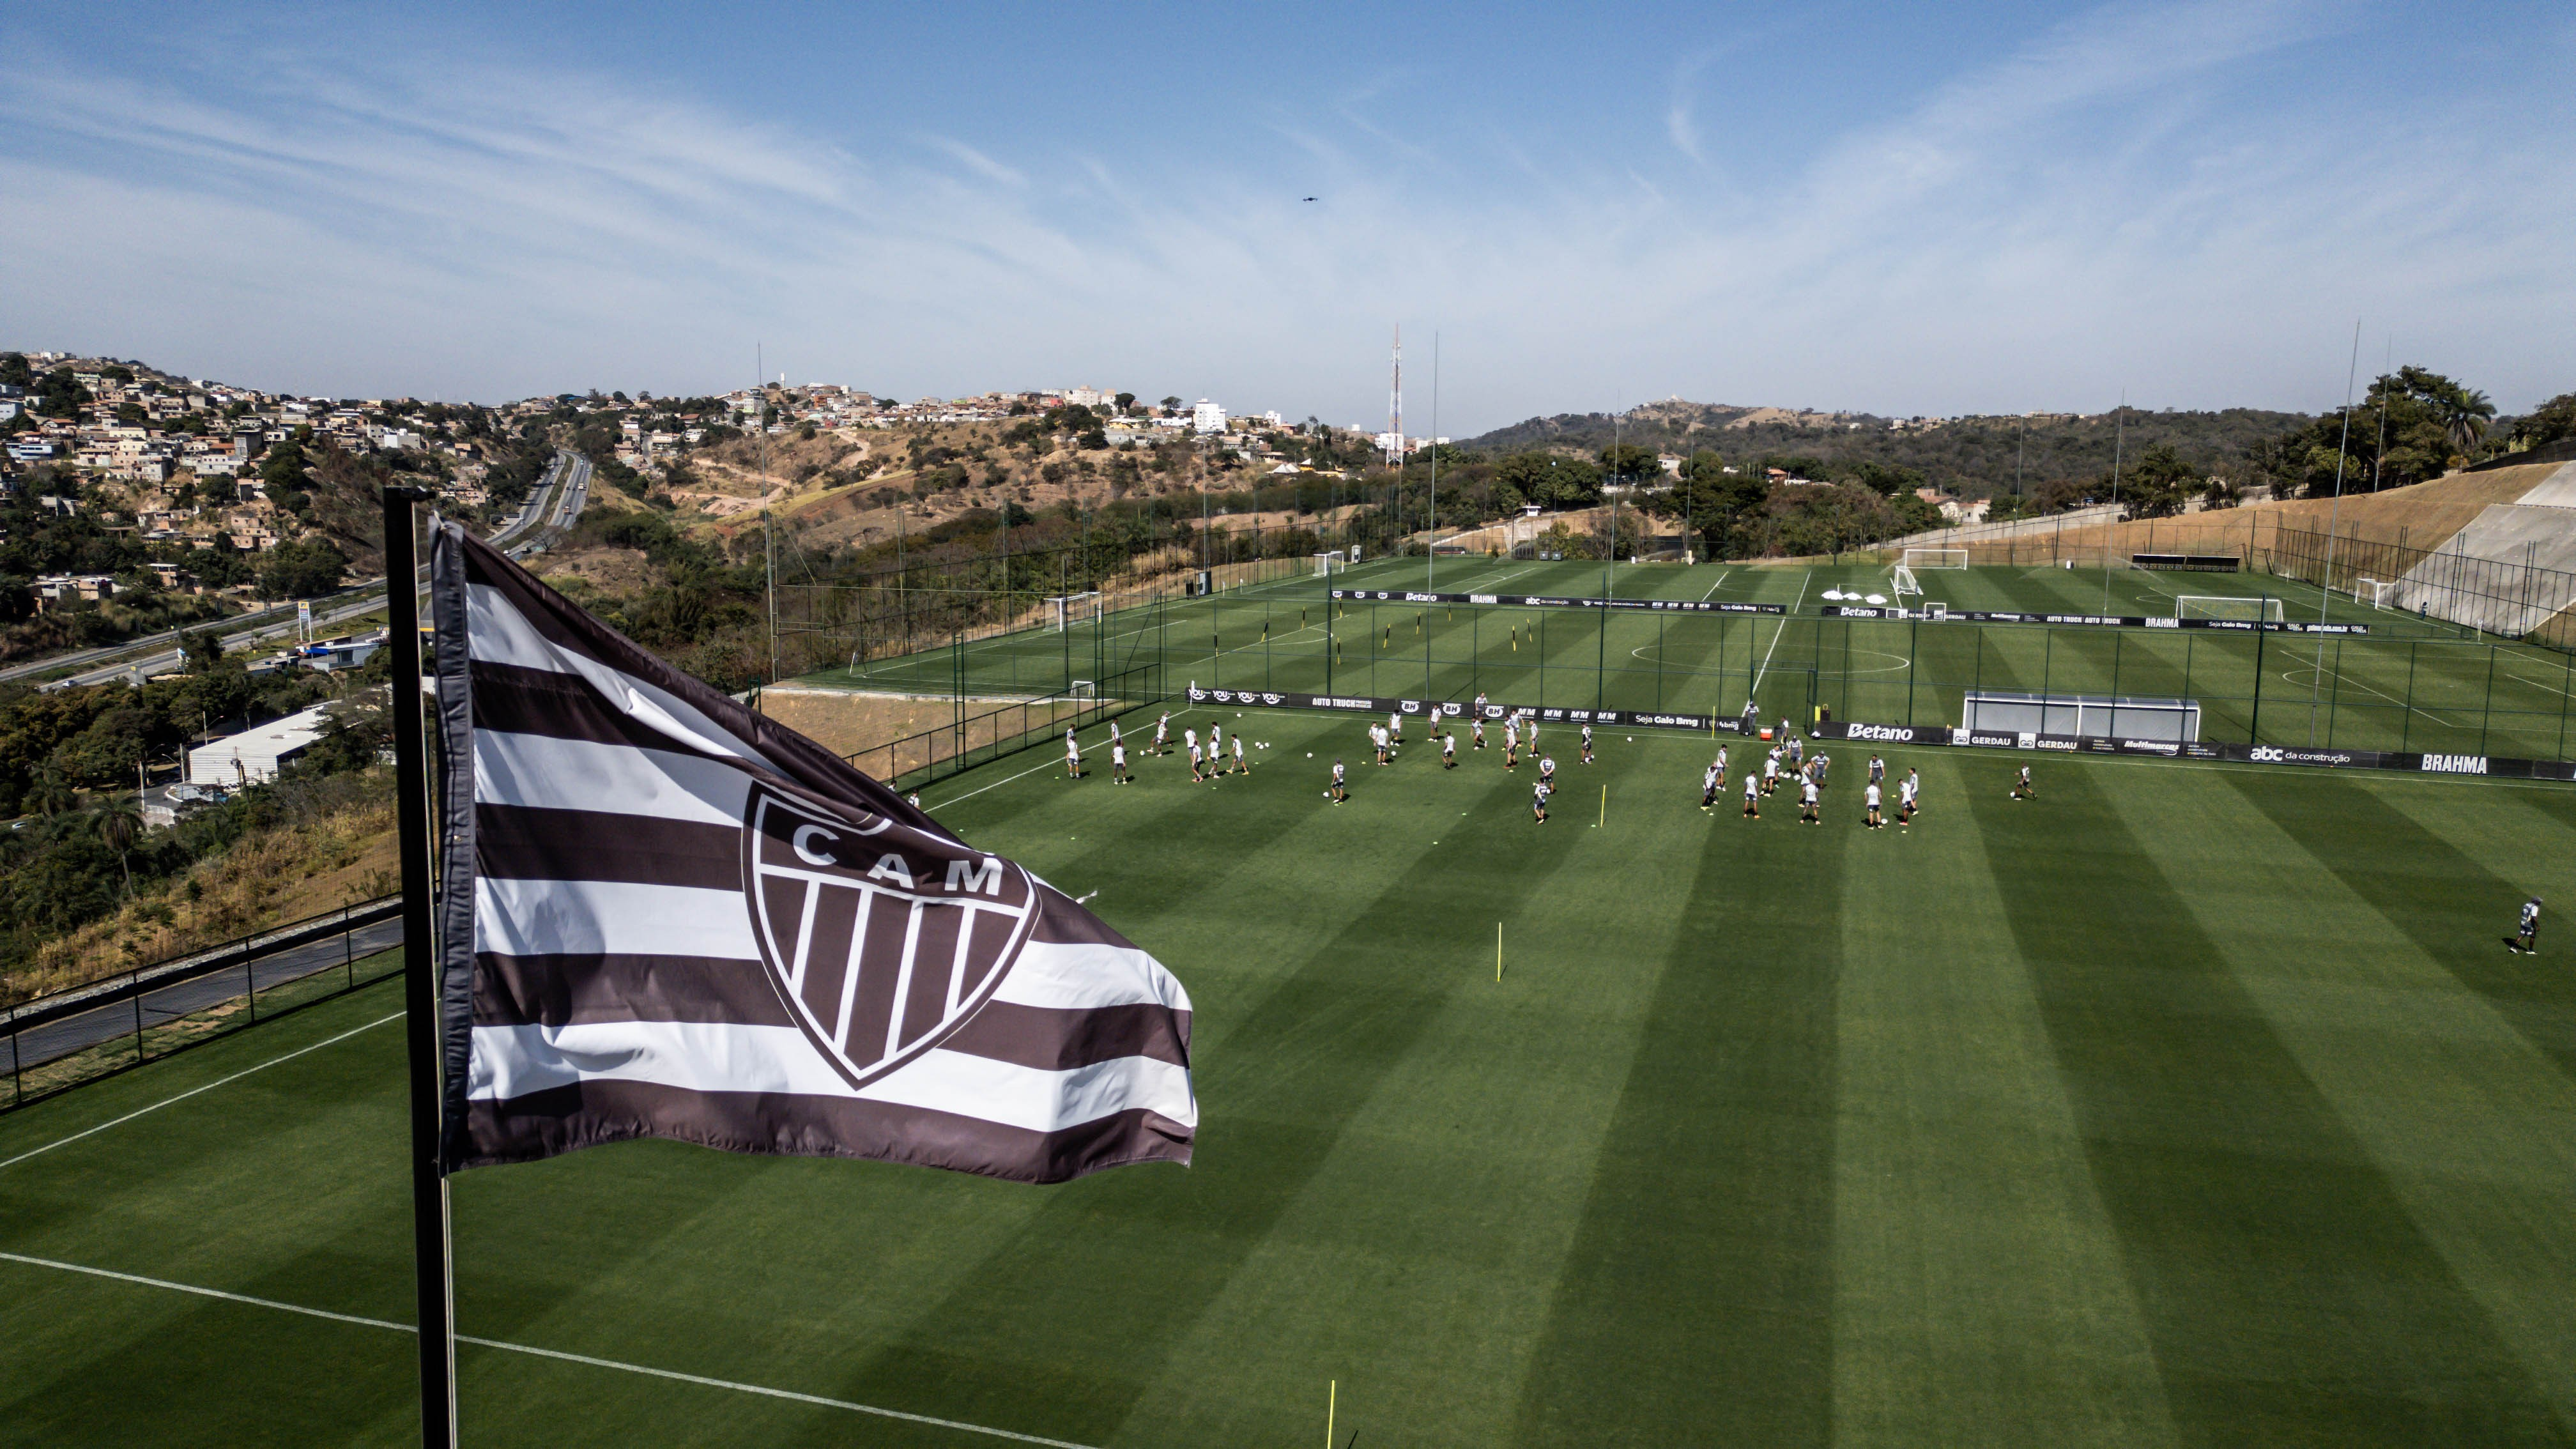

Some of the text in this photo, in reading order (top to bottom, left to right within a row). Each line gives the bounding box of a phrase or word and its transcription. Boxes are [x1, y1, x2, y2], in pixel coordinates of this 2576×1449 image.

[1470, 595, 1497, 604] BRAHMA
[1525, 597, 1540, 605] abc
[1840, 607, 1877, 617] Betano
[2145, 618, 2179, 628] BRAHMA
[1312, 698, 1331, 707] AUTO
[1332, 699, 1356, 708] TRUCK
[1518, 708, 1536, 716] MM
[1544, 709, 1562, 717] MM
[1570, 710, 1589, 719] MM
[1597, 712, 1616, 720] MM
[1635, 715, 1698, 727] Seja Galo Bmg
[1724, 722, 1739, 731] bmg
[1847, 723, 1913, 740] Betano
[1971, 736, 2011, 746] GERDAU
[2037, 739, 2078, 749] GERDAU
[2124, 740, 2180, 751] Multimarcas
[2250, 746, 2283, 762] abc
[2299, 753, 2350, 764] construção
[2421, 754, 2487, 774] BRAHMA
[793, 824, 1003, 896] CAM
